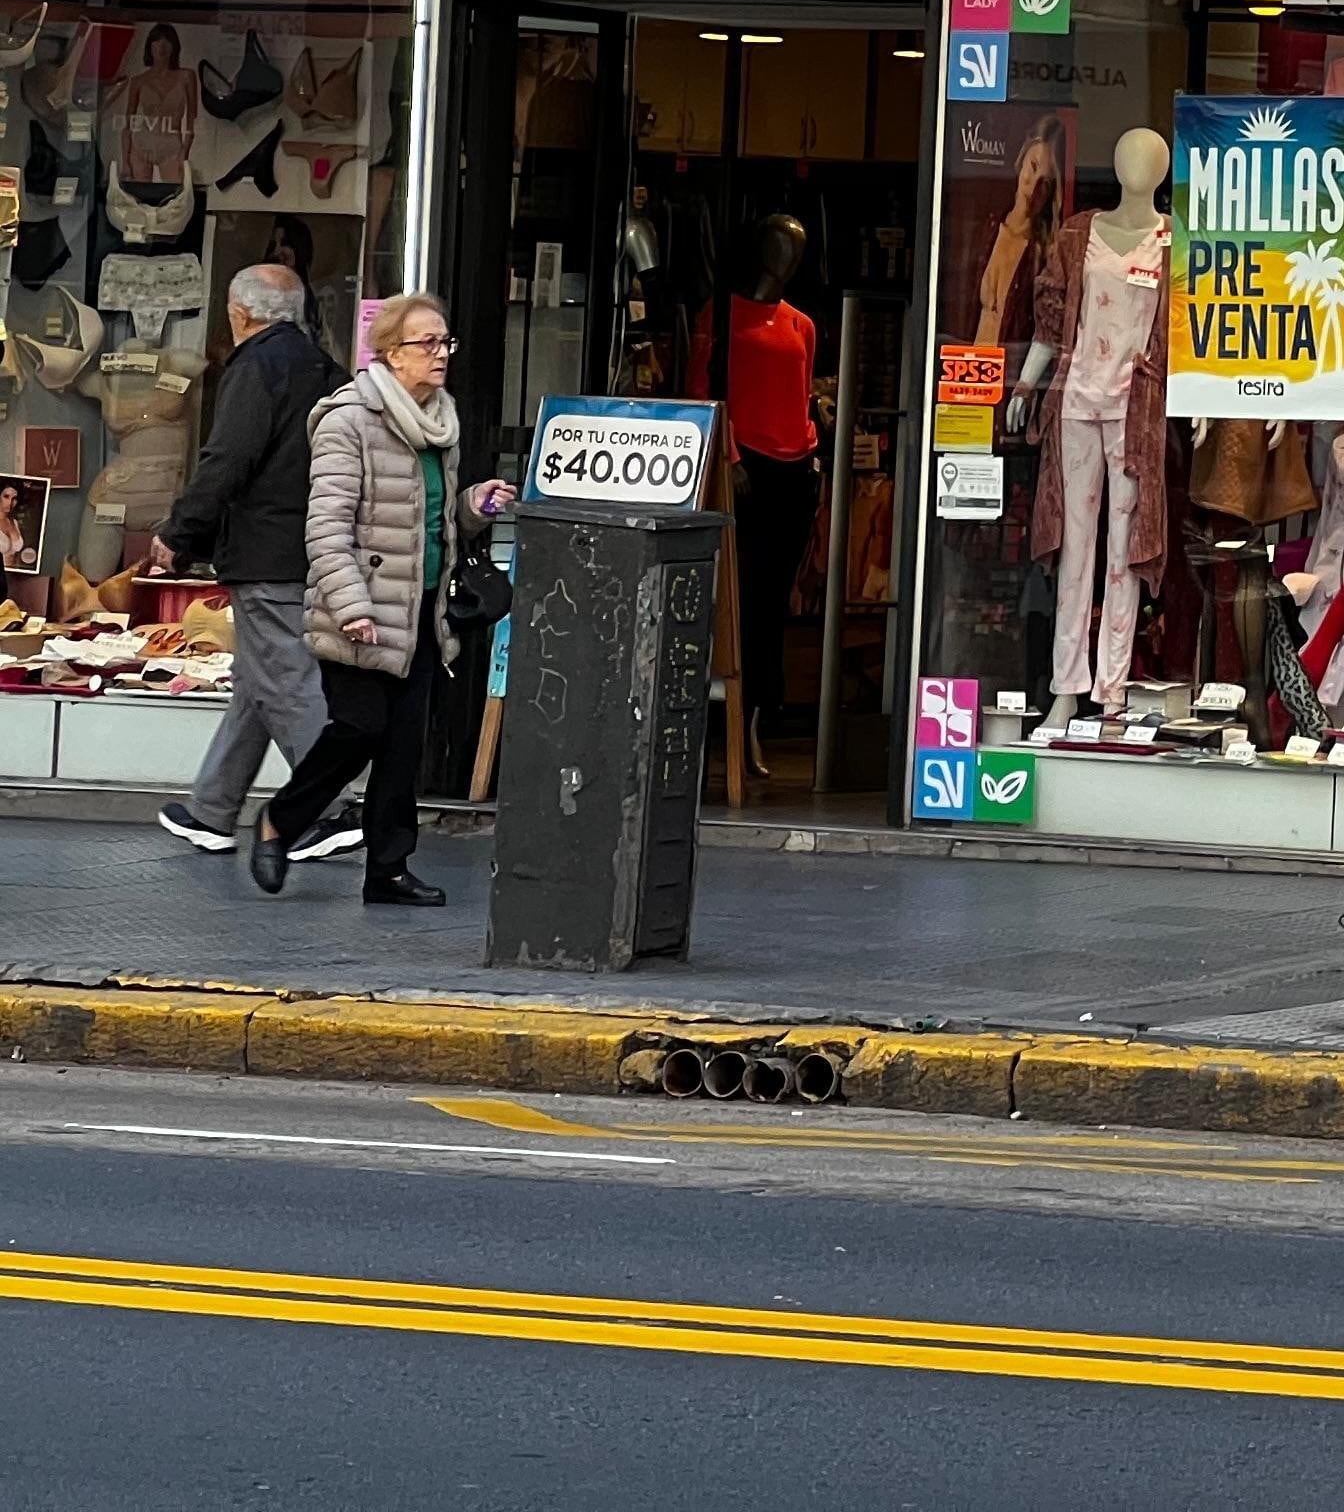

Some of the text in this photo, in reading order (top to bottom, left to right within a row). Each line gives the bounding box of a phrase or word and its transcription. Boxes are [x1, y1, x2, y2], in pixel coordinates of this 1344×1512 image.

[1188, 240, 1266, 297] PRE
[1189, 300, 1318, 361] VENTA
[941, 360, 980, 383] SPS
[1236, 376, 1285, 398] tesira
[552, 428, 693, 448] POR TU COMPRA DE
[542, 448, 694, 488] $40.000
